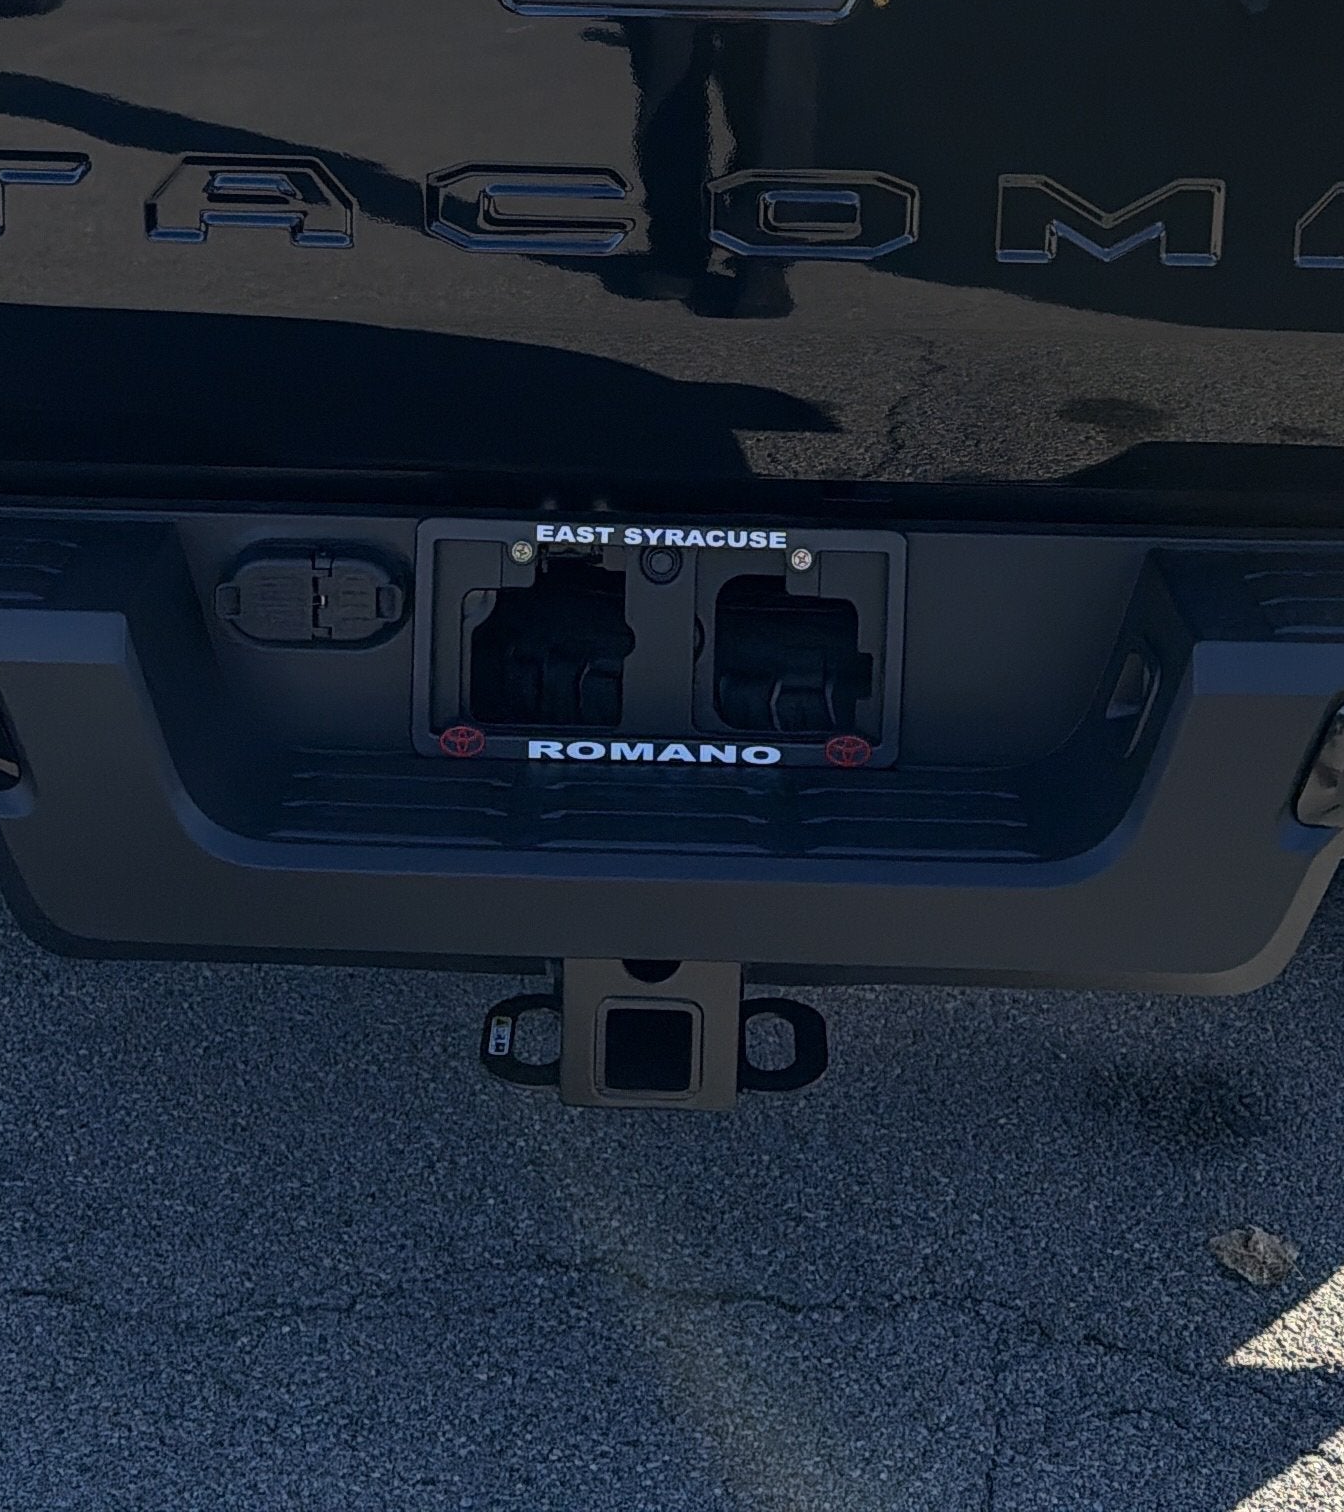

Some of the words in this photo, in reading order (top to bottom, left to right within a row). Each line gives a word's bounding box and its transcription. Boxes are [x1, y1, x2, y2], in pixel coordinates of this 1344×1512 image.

[536, 524, 615, 544] EAST
[623, 528, 788, 549] SYRACUSE
[527, 740, 782, 766] ROMANO
